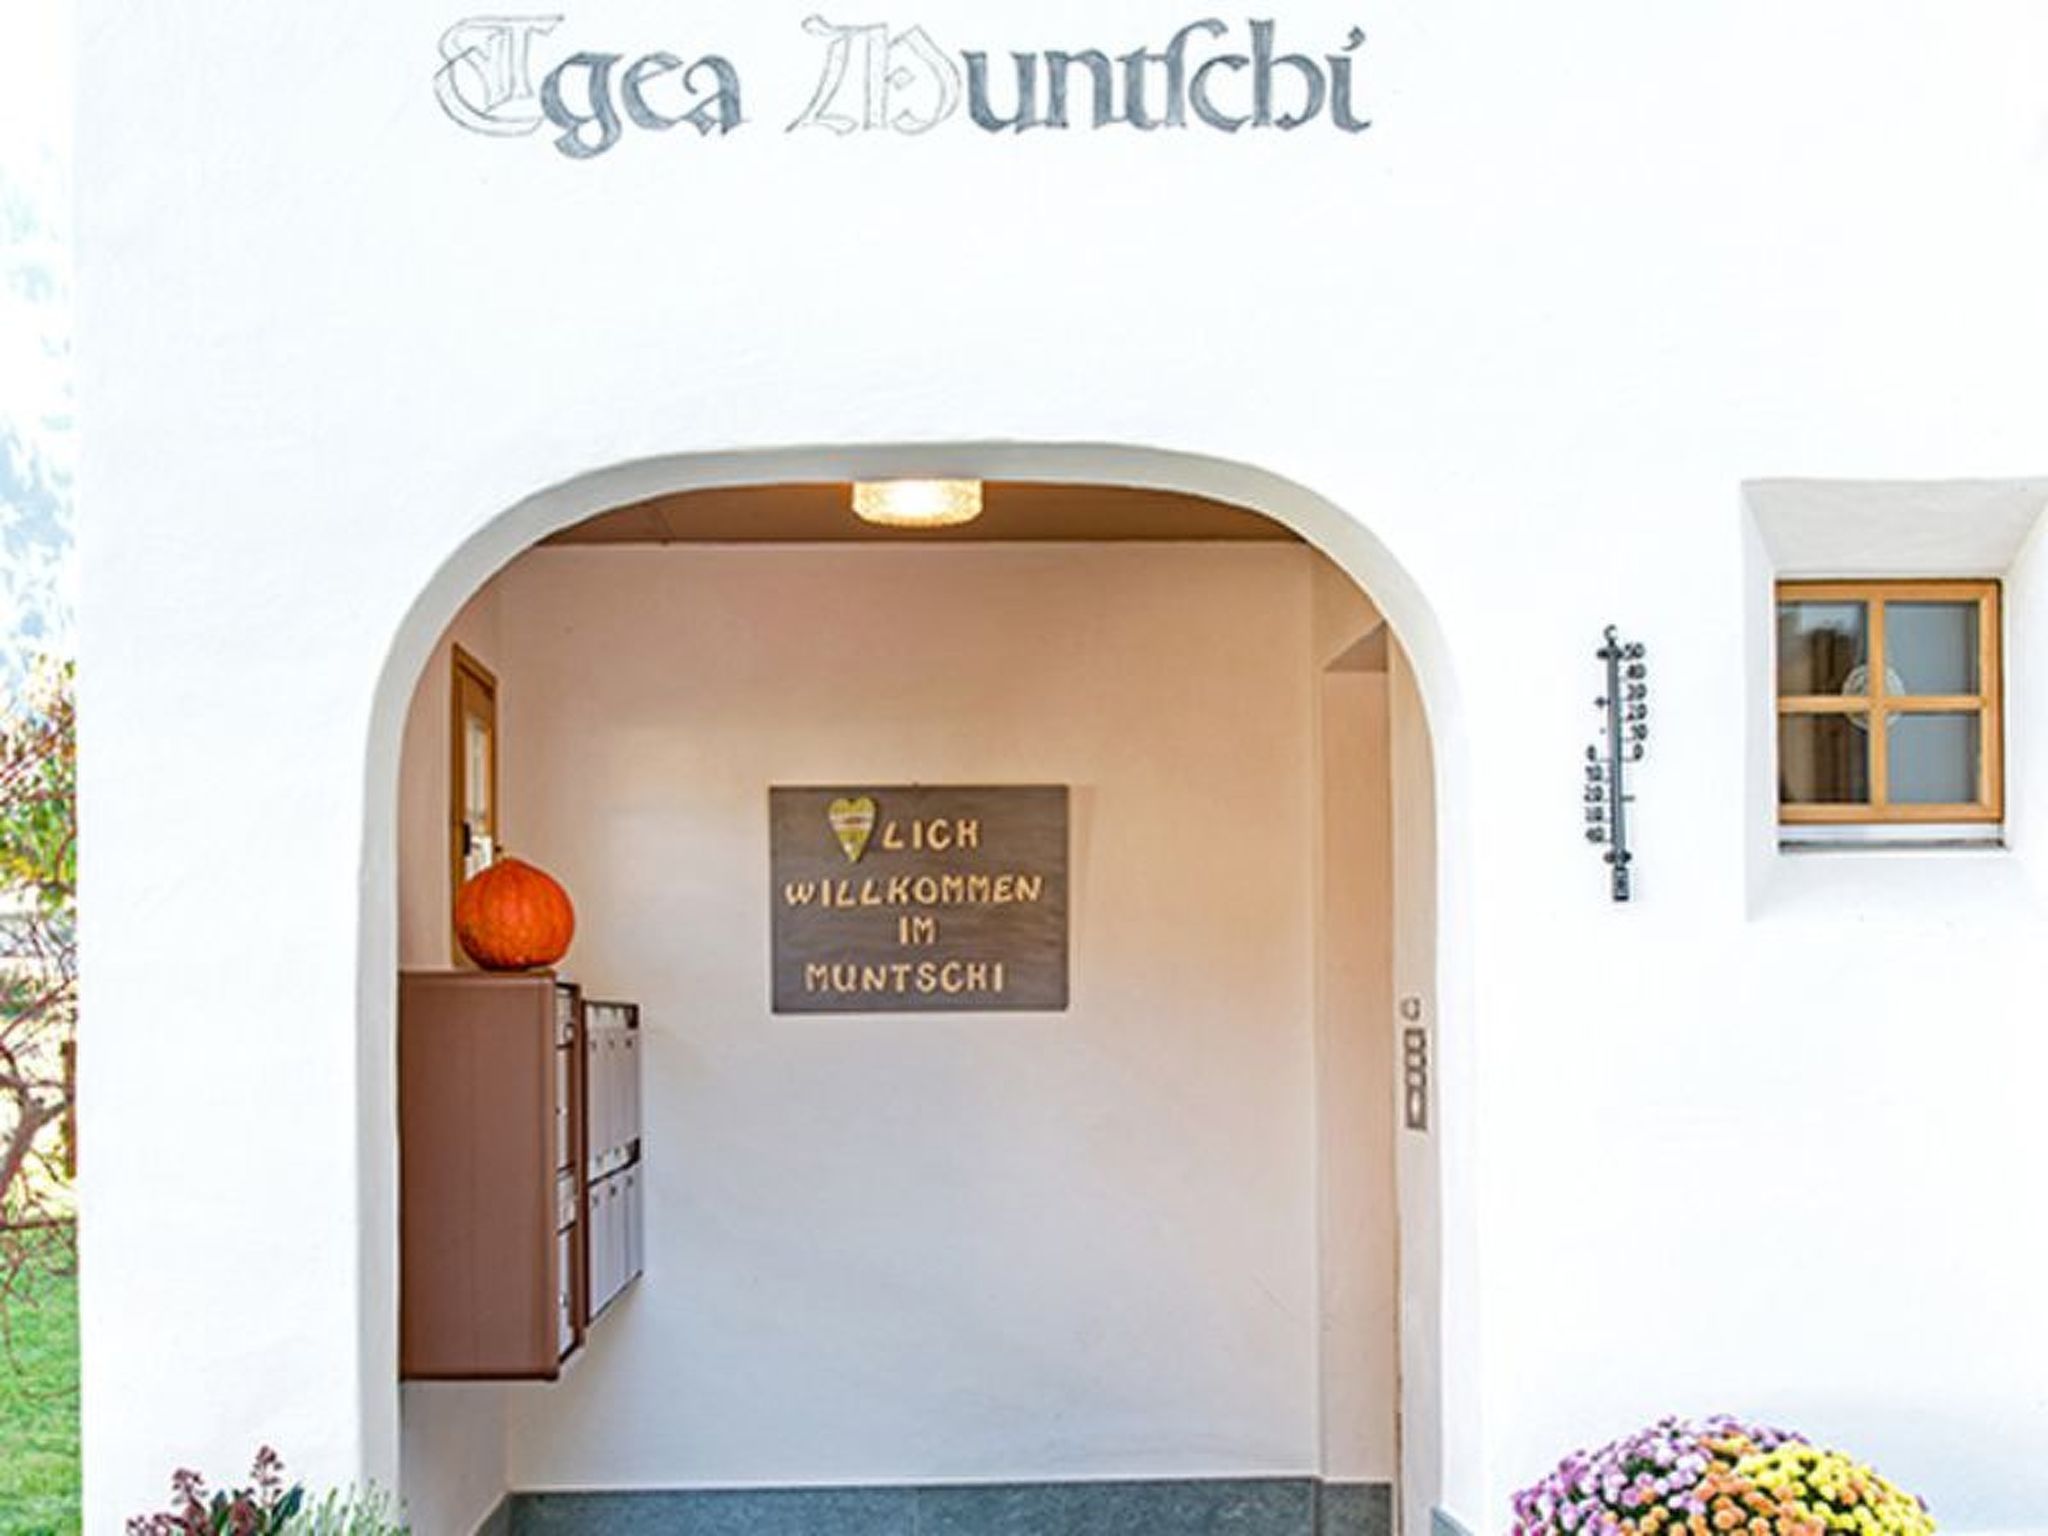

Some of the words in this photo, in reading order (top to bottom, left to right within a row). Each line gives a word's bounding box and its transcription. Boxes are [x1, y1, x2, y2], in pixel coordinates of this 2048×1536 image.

[882, 818, 979, 850] LICH
[785, 874, 1042, 907] WILLKOMMEN
[900, 916, 936, 945] IM
[805, 962, 1003, 993] MUNTSCHI
